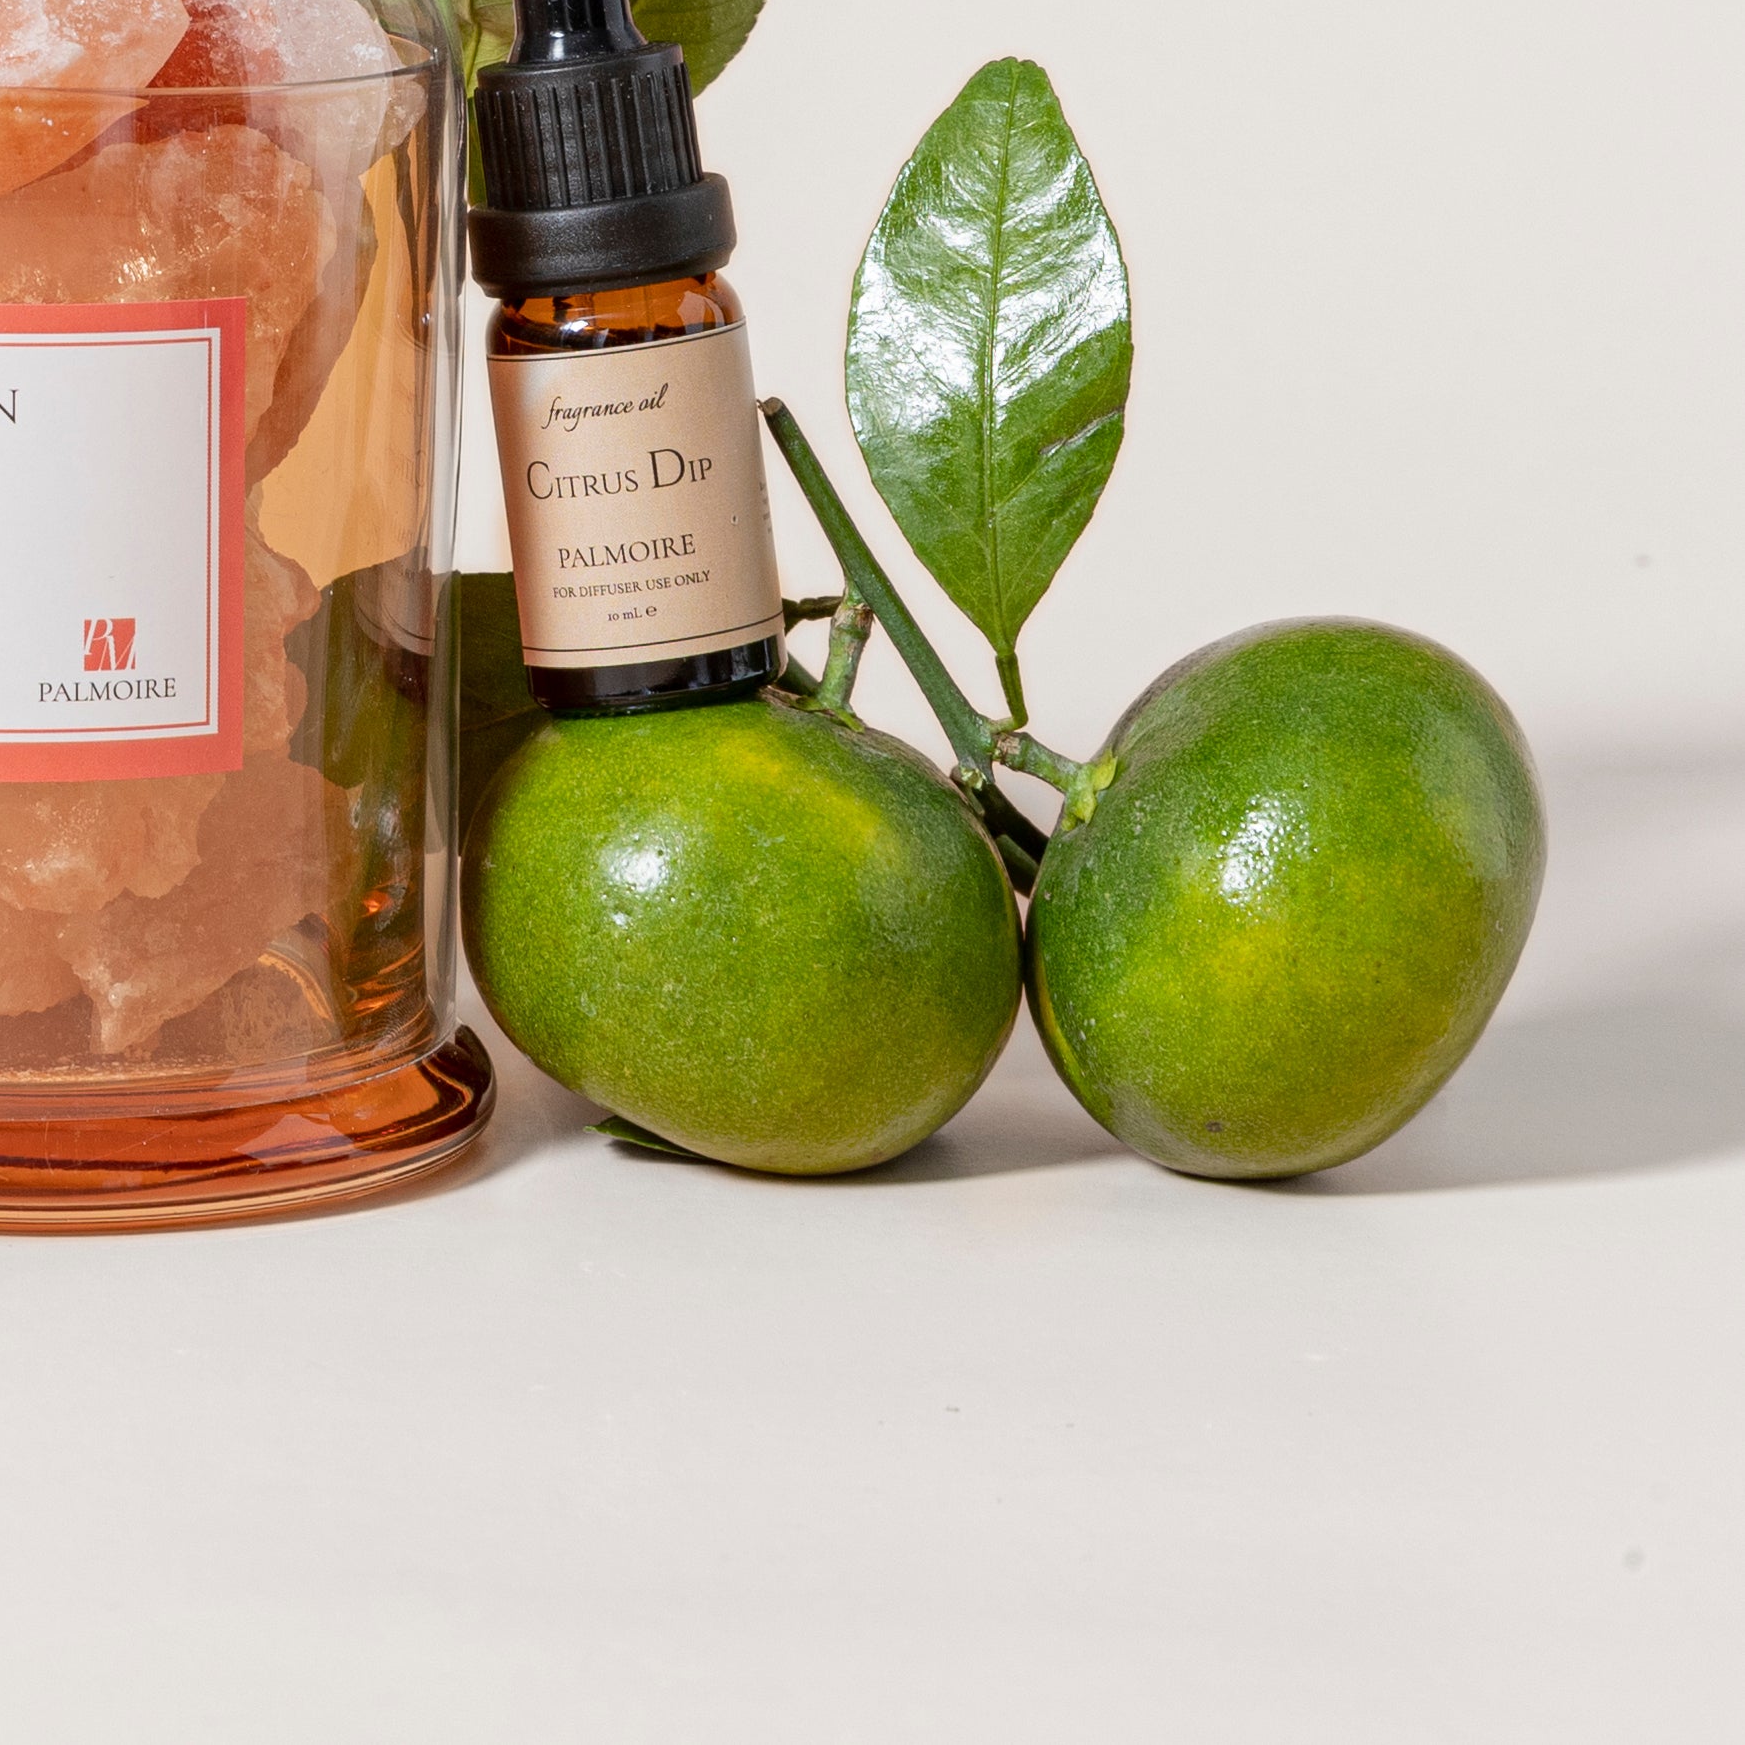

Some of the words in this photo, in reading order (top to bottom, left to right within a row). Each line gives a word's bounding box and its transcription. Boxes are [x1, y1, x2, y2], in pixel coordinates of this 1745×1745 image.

[541, 396, 634, 432] fragrance
[638, 382, 669, 412] oil
[526, 460, 639, 501] CITRUS
[648, 448, 713, 489] DIP
[557, 533, 697, 569] PALMOIRE
[553, 586, 577, 598] FOR
[579, 581, 642, 598] DIFFUSER
[645, 576, 671, 591] USE
[674, 569, 711, 587] ONLY
[622, 607, 643, 621] mL
[38, 677, 177, 703] PALMOIRE
